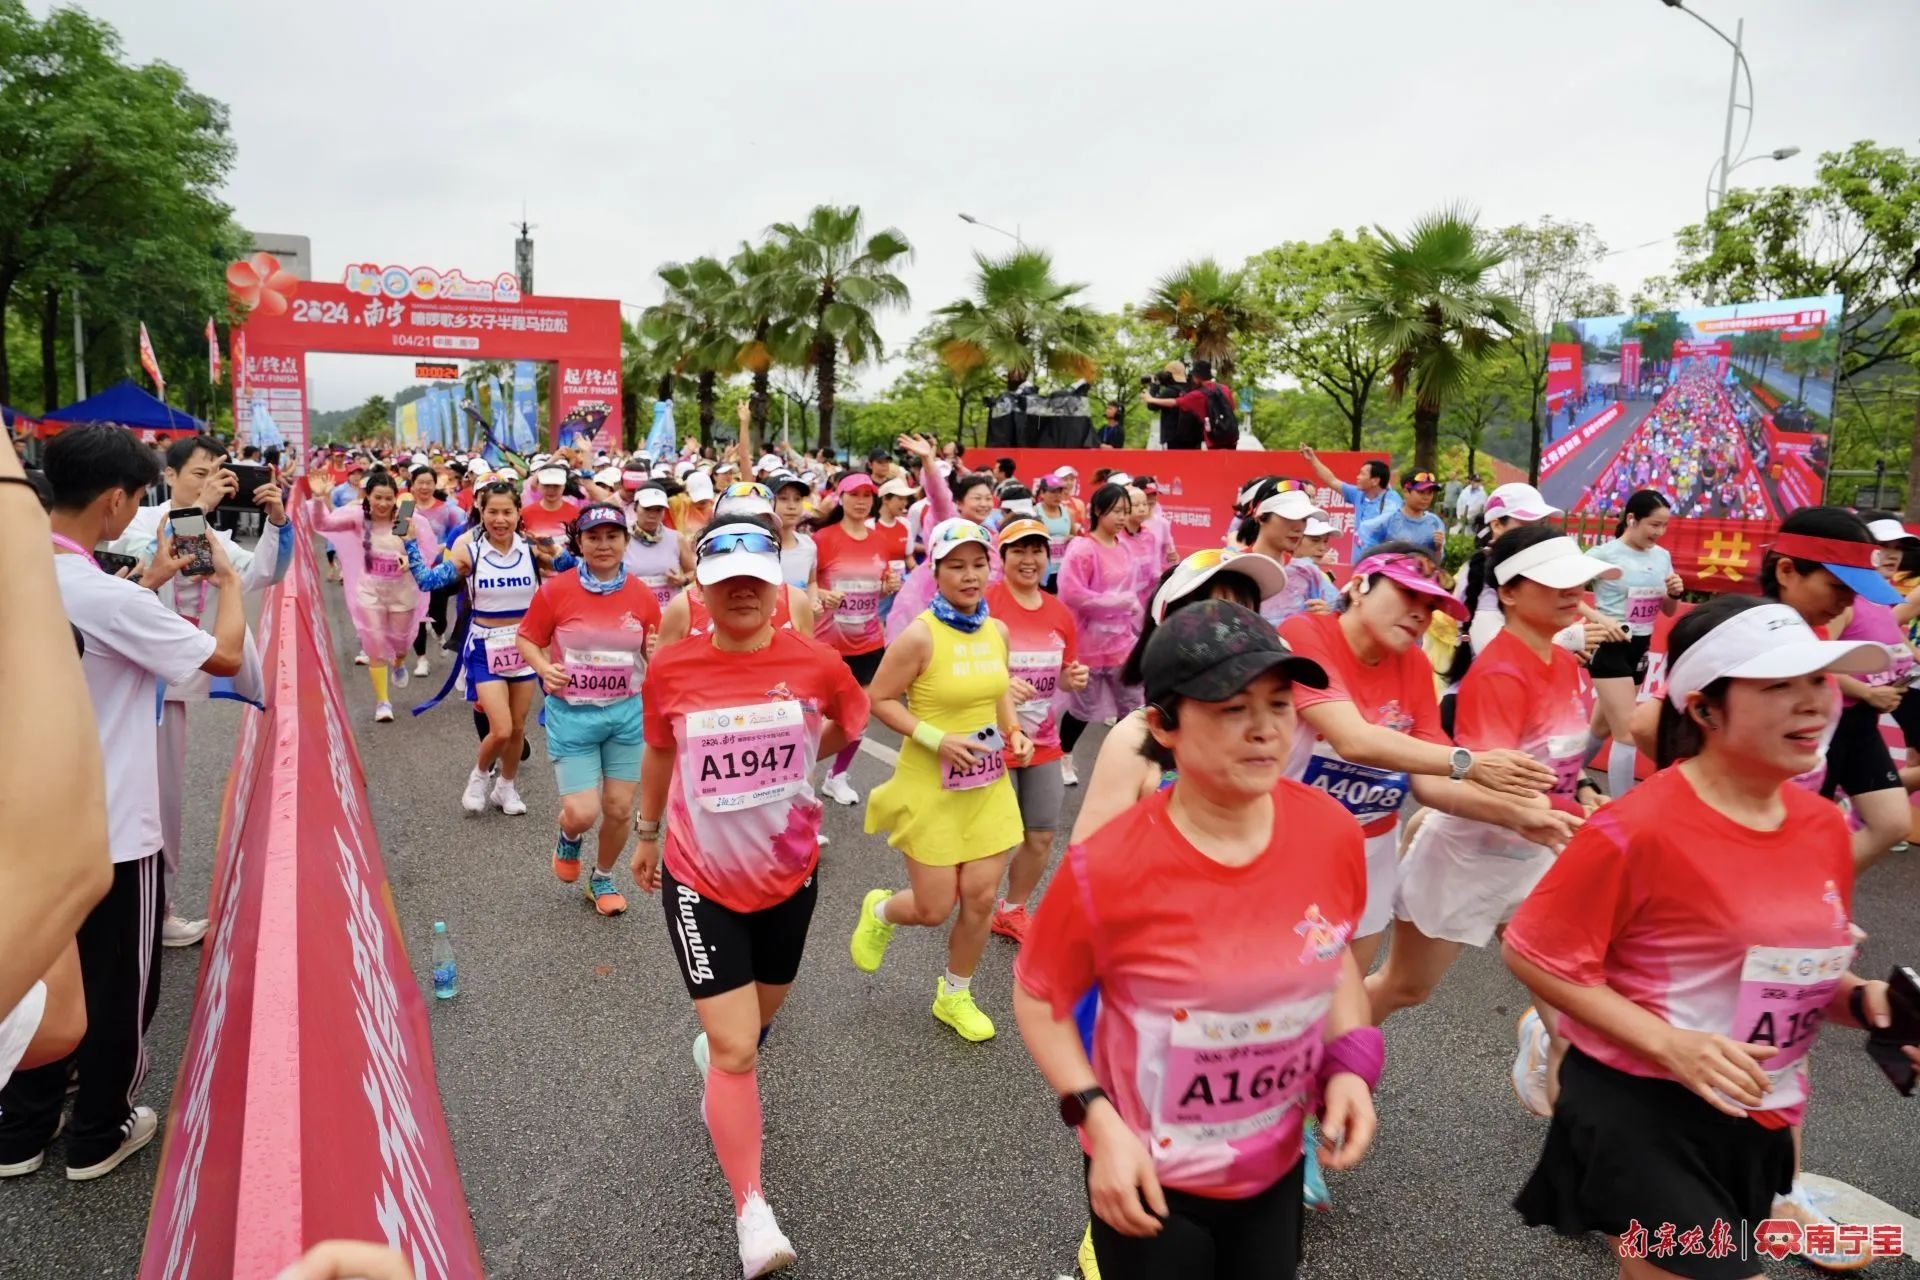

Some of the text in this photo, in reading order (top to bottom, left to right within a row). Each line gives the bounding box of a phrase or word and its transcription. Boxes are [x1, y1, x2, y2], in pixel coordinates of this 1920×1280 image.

[567, 673, 627, 691] A3040A
[700, 743, 797, 782] A1947
[1310, 774, 1402, 807] A4008
[676, 885, 717, 984] Running
